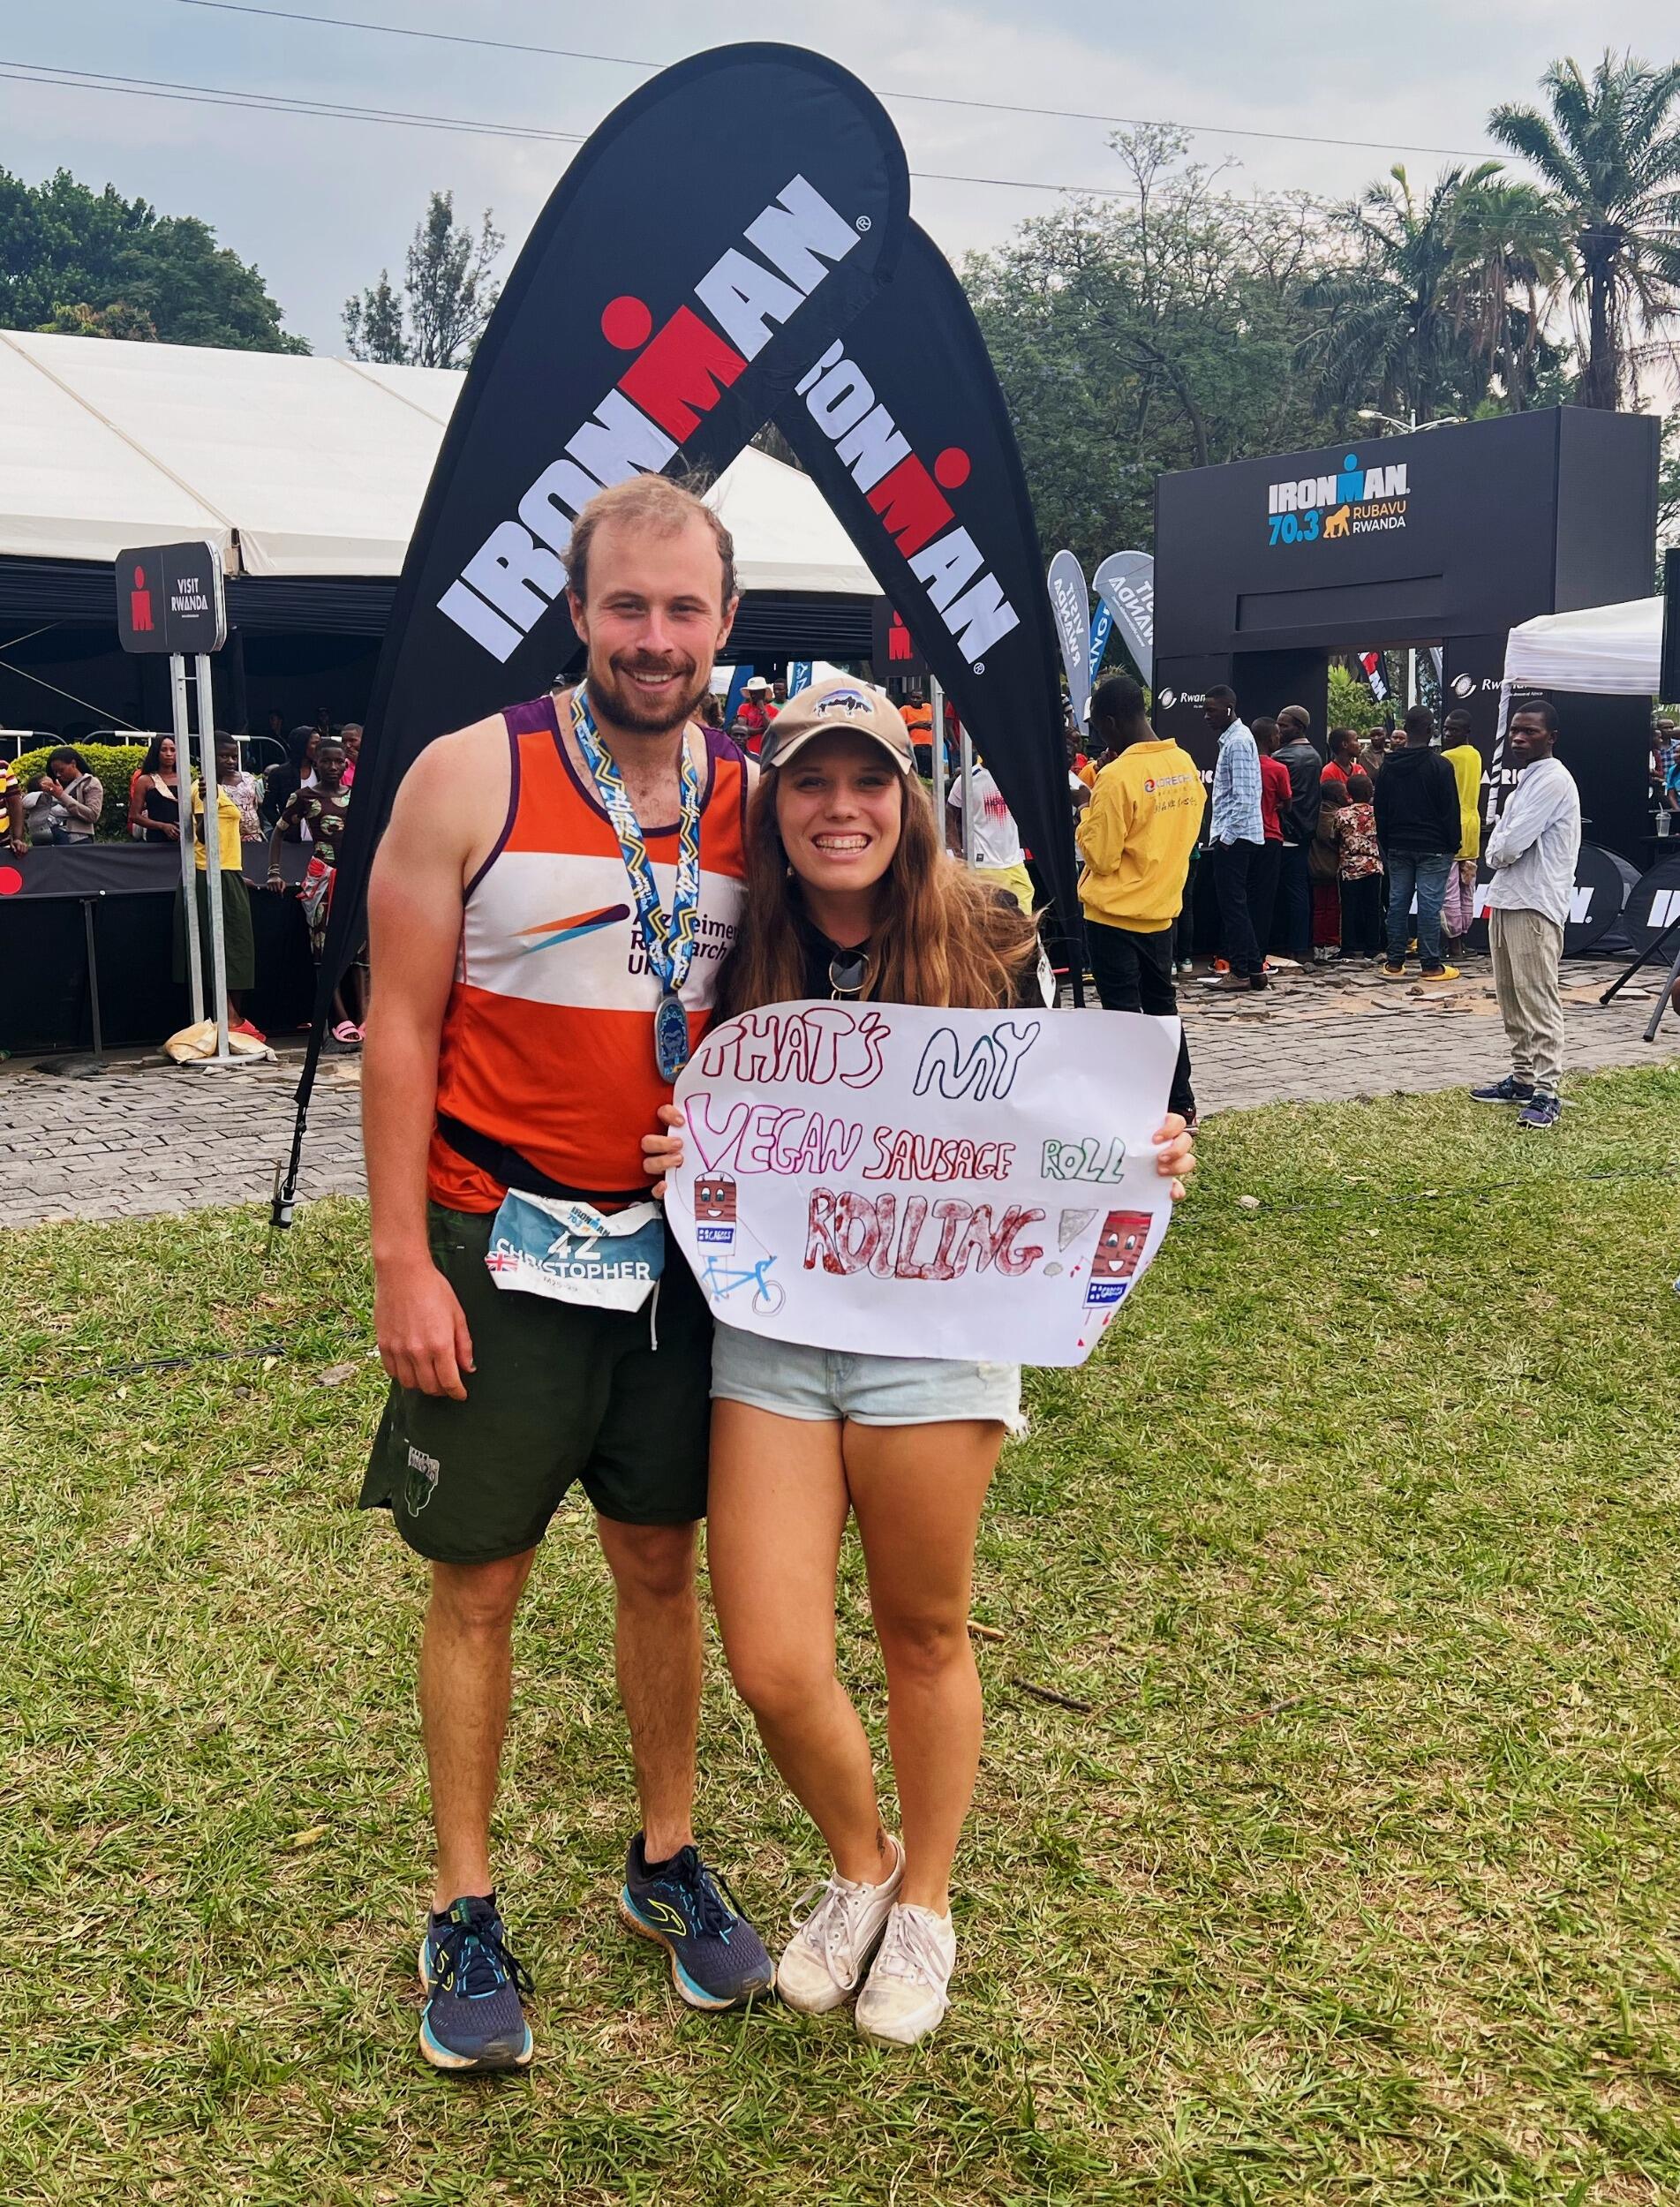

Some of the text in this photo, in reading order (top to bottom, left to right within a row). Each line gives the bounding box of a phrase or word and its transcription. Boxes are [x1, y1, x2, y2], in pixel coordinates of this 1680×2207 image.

[437, 174, 861, 663] IRONMAN
[1269, 454, 1407, 514] IRONMAN
[1352, 500, 1406, 520] RUBAVU
[1352, 516, 1406, 534] RWANDA
[1269, 509, 1319, 546] 70.3
[177, 577, 199, 594] VISIT
[170, 594, 208, 612] RWANDA
[1179, 691, 1206, 704] Rwan
[630, 930, 727, 961] Rarch
[699, 1007, 1042, 1102] THAT'S MY
[685, 1092, 1127, 1184] VEGAN SAUSAGE ROLL
[547, 1231, 601, 1261] 42
[804, 1186, 1099, 1281] ROLLING!
